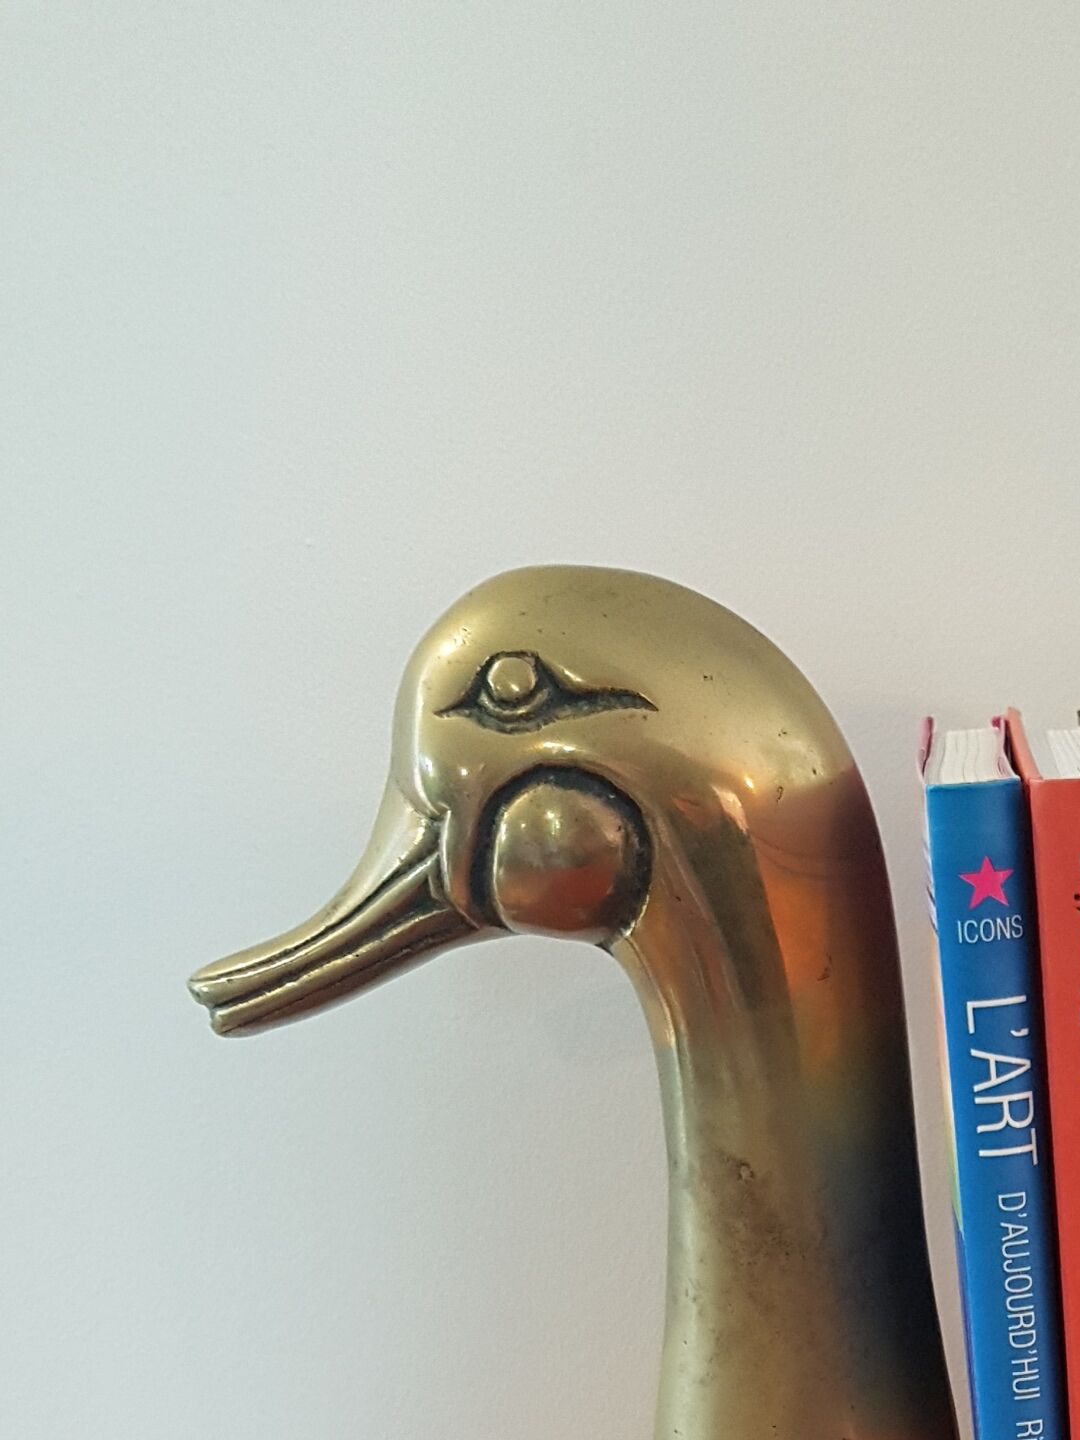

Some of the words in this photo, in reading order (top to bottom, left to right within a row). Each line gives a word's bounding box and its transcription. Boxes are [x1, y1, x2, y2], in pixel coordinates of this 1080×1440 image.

[957, 913, 1024, 945] ICONS
[966, 995, 1040, 1166] L'ART
[997, 1190, 1041, 1402] D'AUJOURD'HUI
